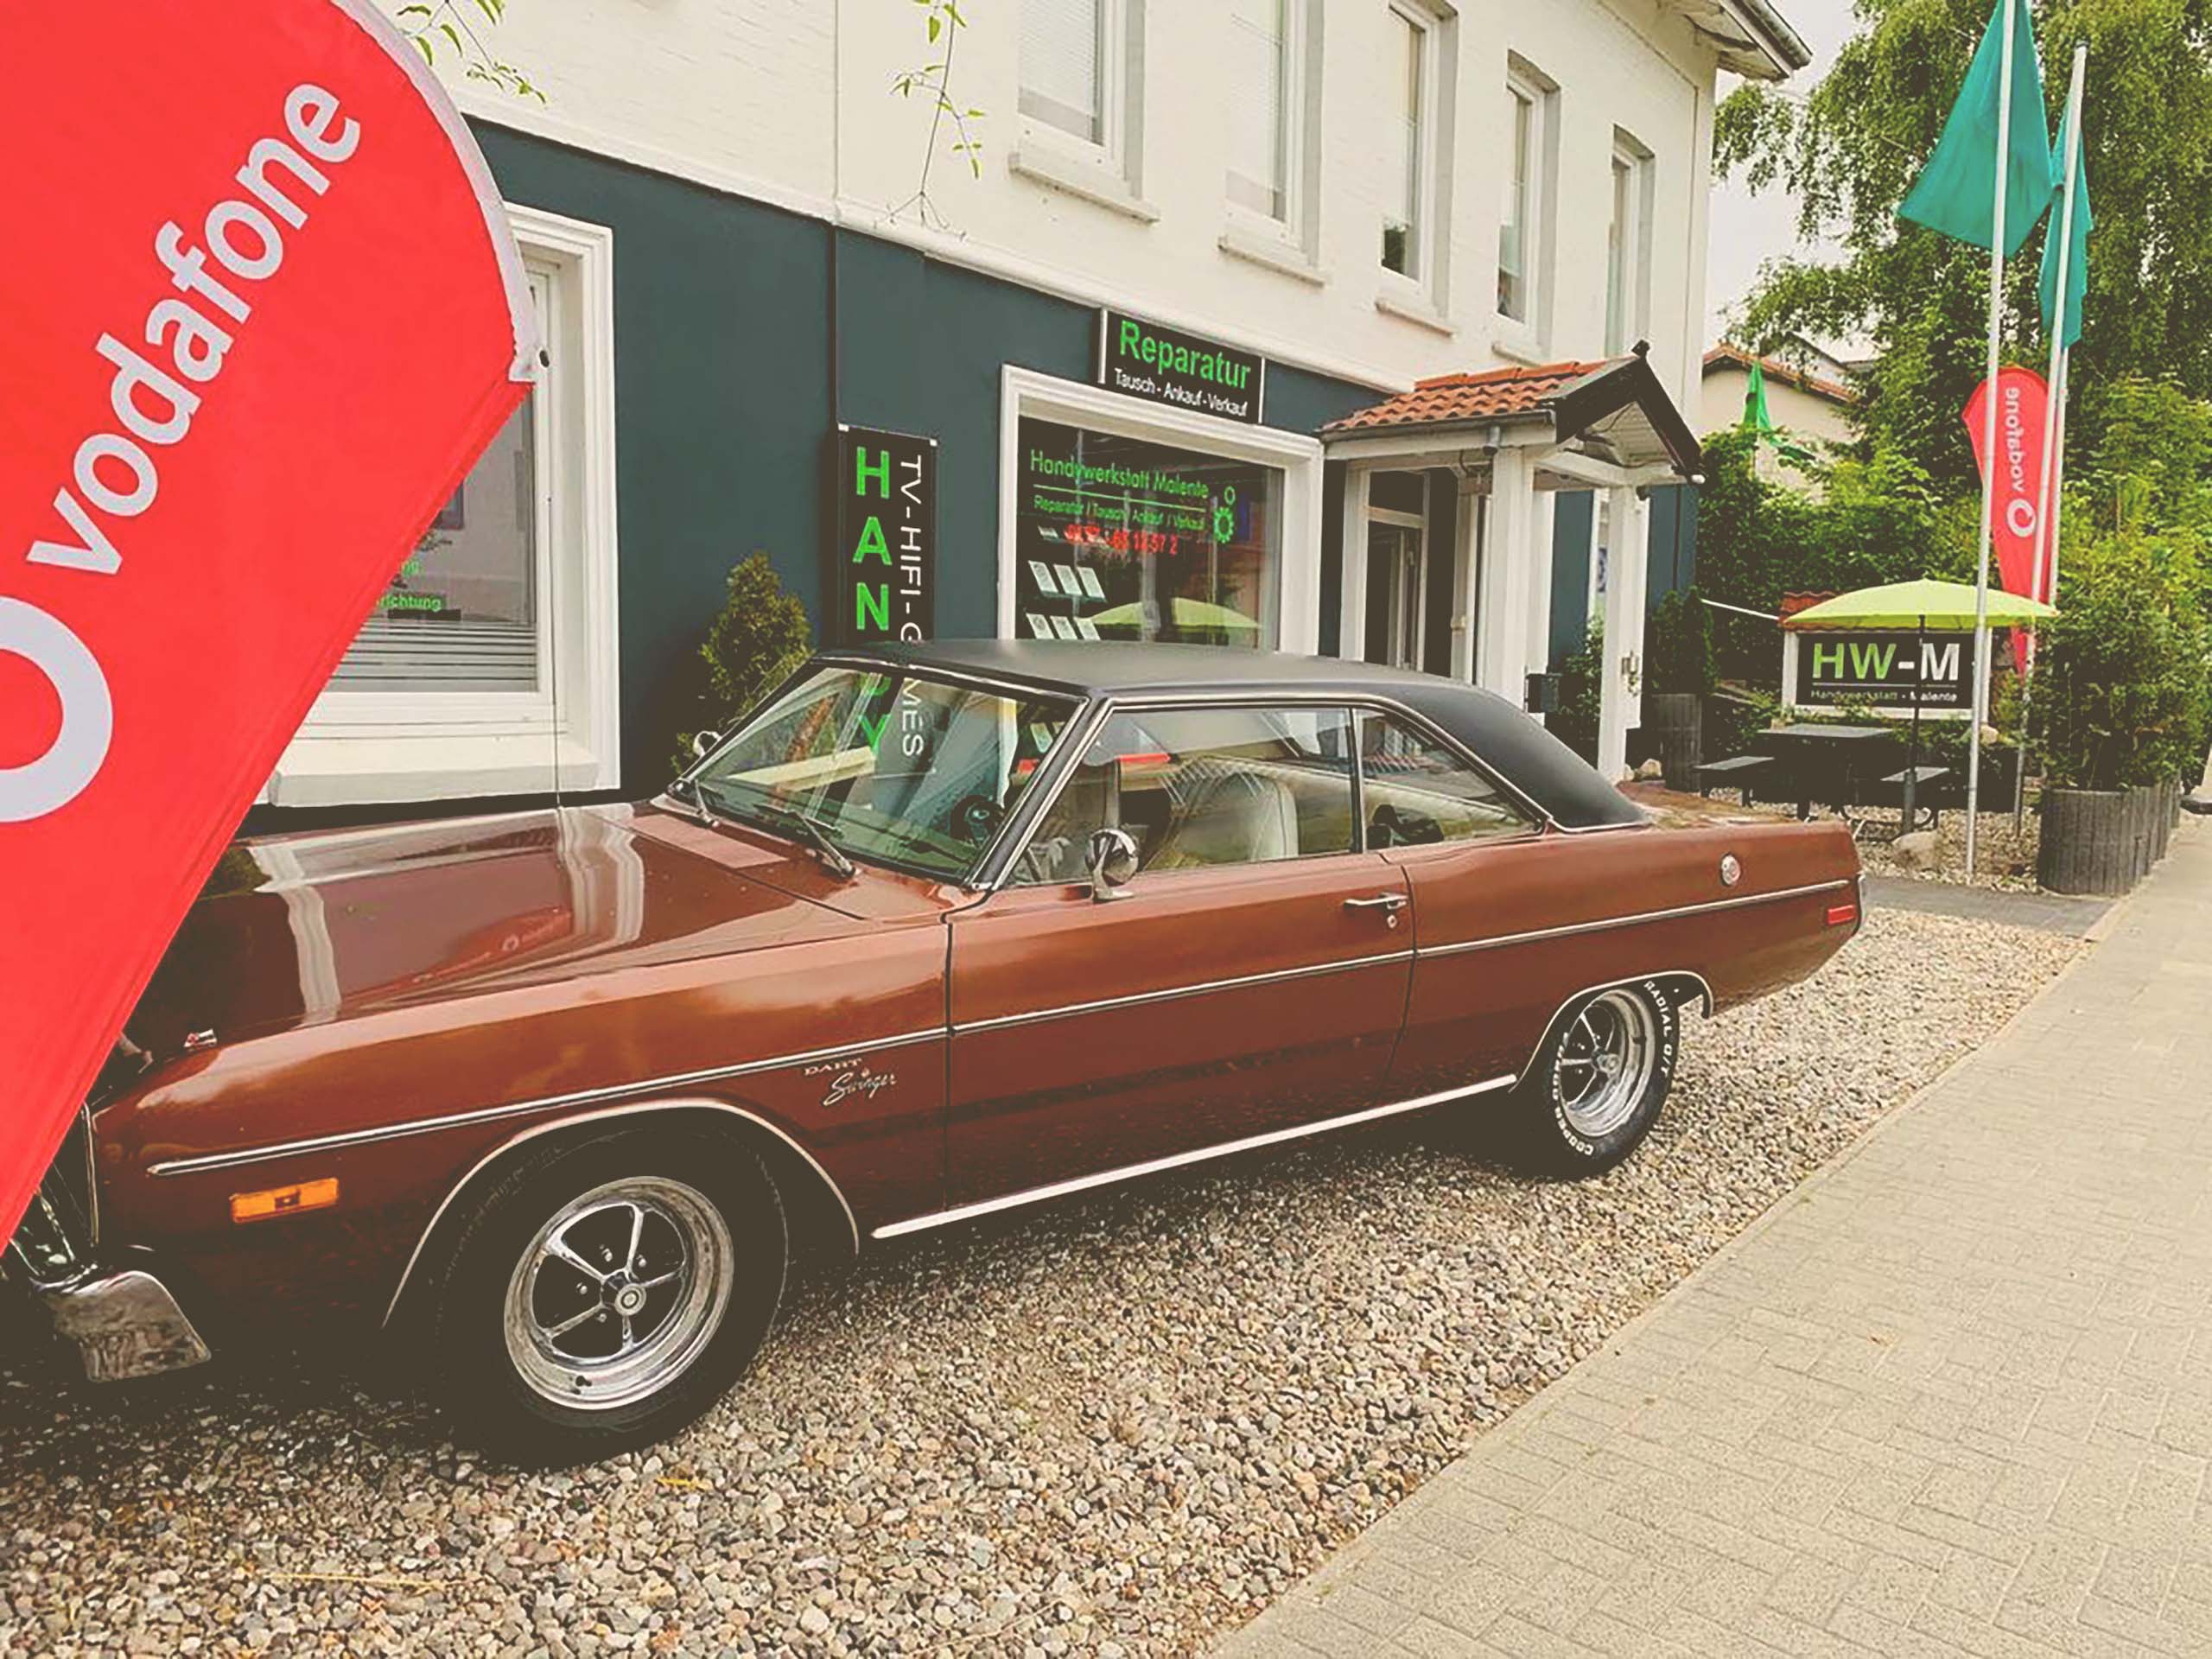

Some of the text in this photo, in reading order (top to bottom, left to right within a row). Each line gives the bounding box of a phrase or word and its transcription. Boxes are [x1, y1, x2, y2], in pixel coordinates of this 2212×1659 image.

[26, 83, 360, 575] vodafone
[1120, 320, 1251, 389] Reparatur
[1114, 366, 1155, 394] Tausch
[1208, 393, 1248, 416] Verkauf
[1812, 643, 1961, 681] HW-M
[1643, 981, 1673, 1038] RADIAL
